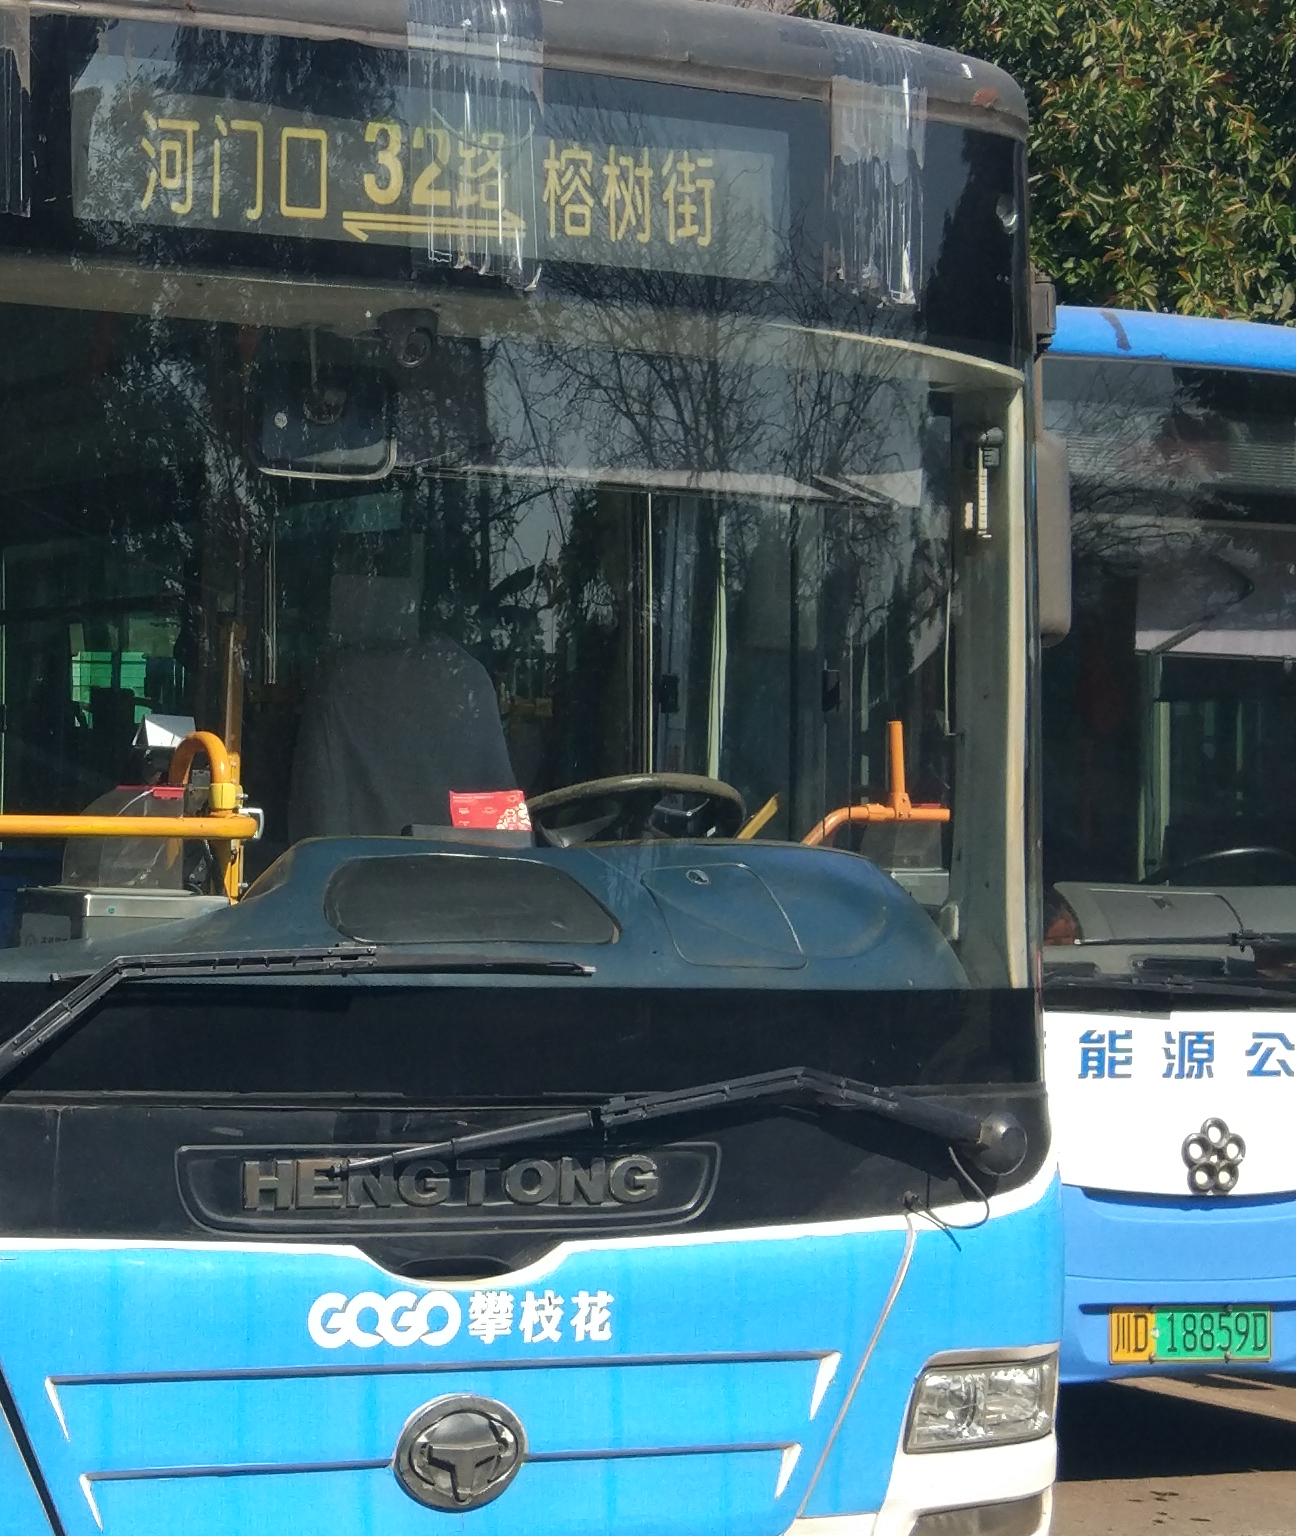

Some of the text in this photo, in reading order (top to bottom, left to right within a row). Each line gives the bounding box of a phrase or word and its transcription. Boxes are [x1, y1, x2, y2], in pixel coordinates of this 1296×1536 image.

[141, 109, 716, 247] 河门口 32路 榕树街
[1045, 1029, 1296, 1080] 能源公
[243, 1154, 659, 1210] HENGTONG
[308, 1290, 615, 1349] GOGO 攀枝花
